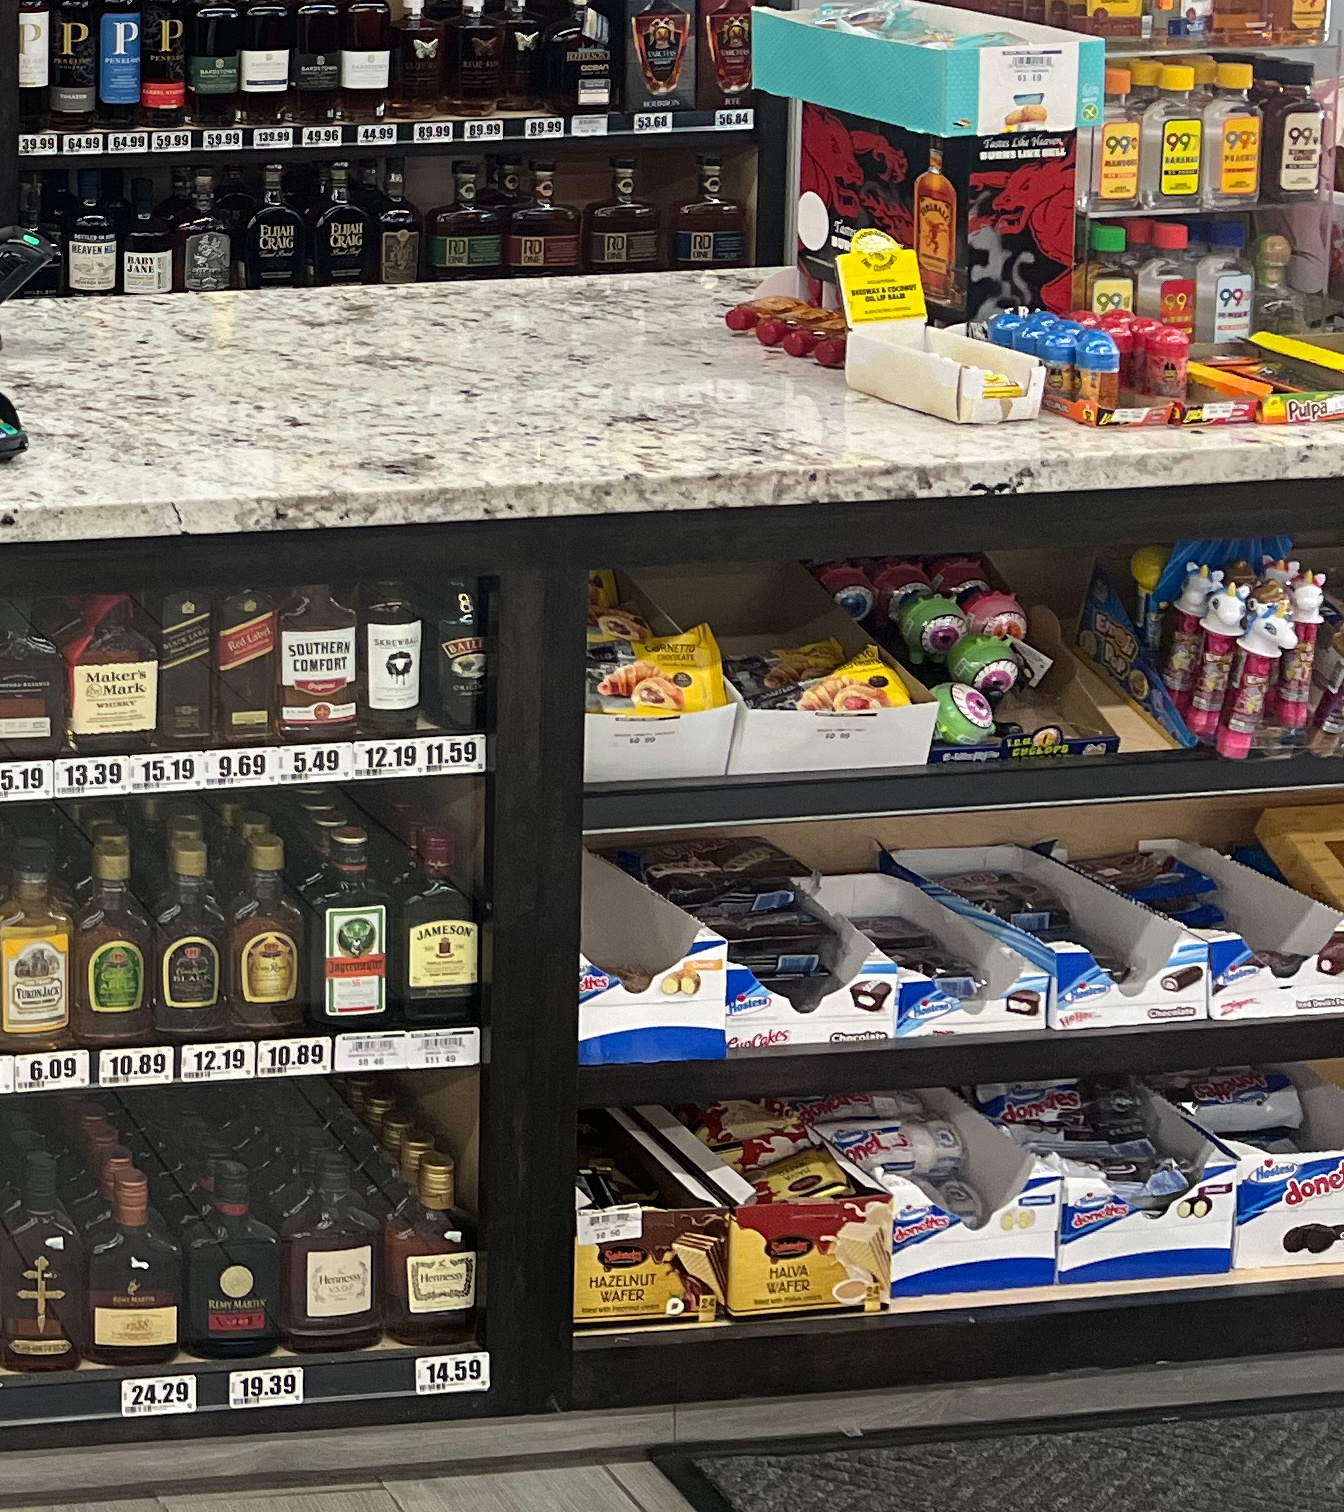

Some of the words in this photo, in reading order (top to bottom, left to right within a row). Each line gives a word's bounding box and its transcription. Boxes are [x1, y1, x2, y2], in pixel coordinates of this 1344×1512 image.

[113, 22, 138, 54] P
[725, 98, 741, 106] RYE
[331, 223, 363, 235] ELIJAH
[330, 233, 362, 247] CRAIG
[128, 256, 154, 265] BABY
[128, 264, 155, 274] JANE
[288, 641, 350, 657] SOUTHERN
[644, 644, 695, 653] CORNETTO
[293, 656, 348, 671] COMFORT
[85, 669, 147, 684] Maker's
[103, 682, 146, 695] Mark
[218, 753, 266, 778] 9.69
[293, 748, 340, 773] 5.49
[64, 761, 122, 786] 13.39
[416, 924, 474, 940] JAMESON
[1148, 1007, 1196, 1018] Chocolate
[193, 1047, 245, 1071] 12.19
[268, 1042, 324, 1066] 10.89
[1073, 1204, 1129, 1228] donettes
[770, 1266, 808, 1279] HALVA
[589, 1274, 656, 1288] HAZELNUT
[767, 1280, 810, 1293] WAFER
[601, 1289, 644, 1302] WAFER
[426, 1360, 482, 1384] 14.59
[240, 1374, 296, 1397] 19.39
[131, 1382, 189, 1406] 24.29
